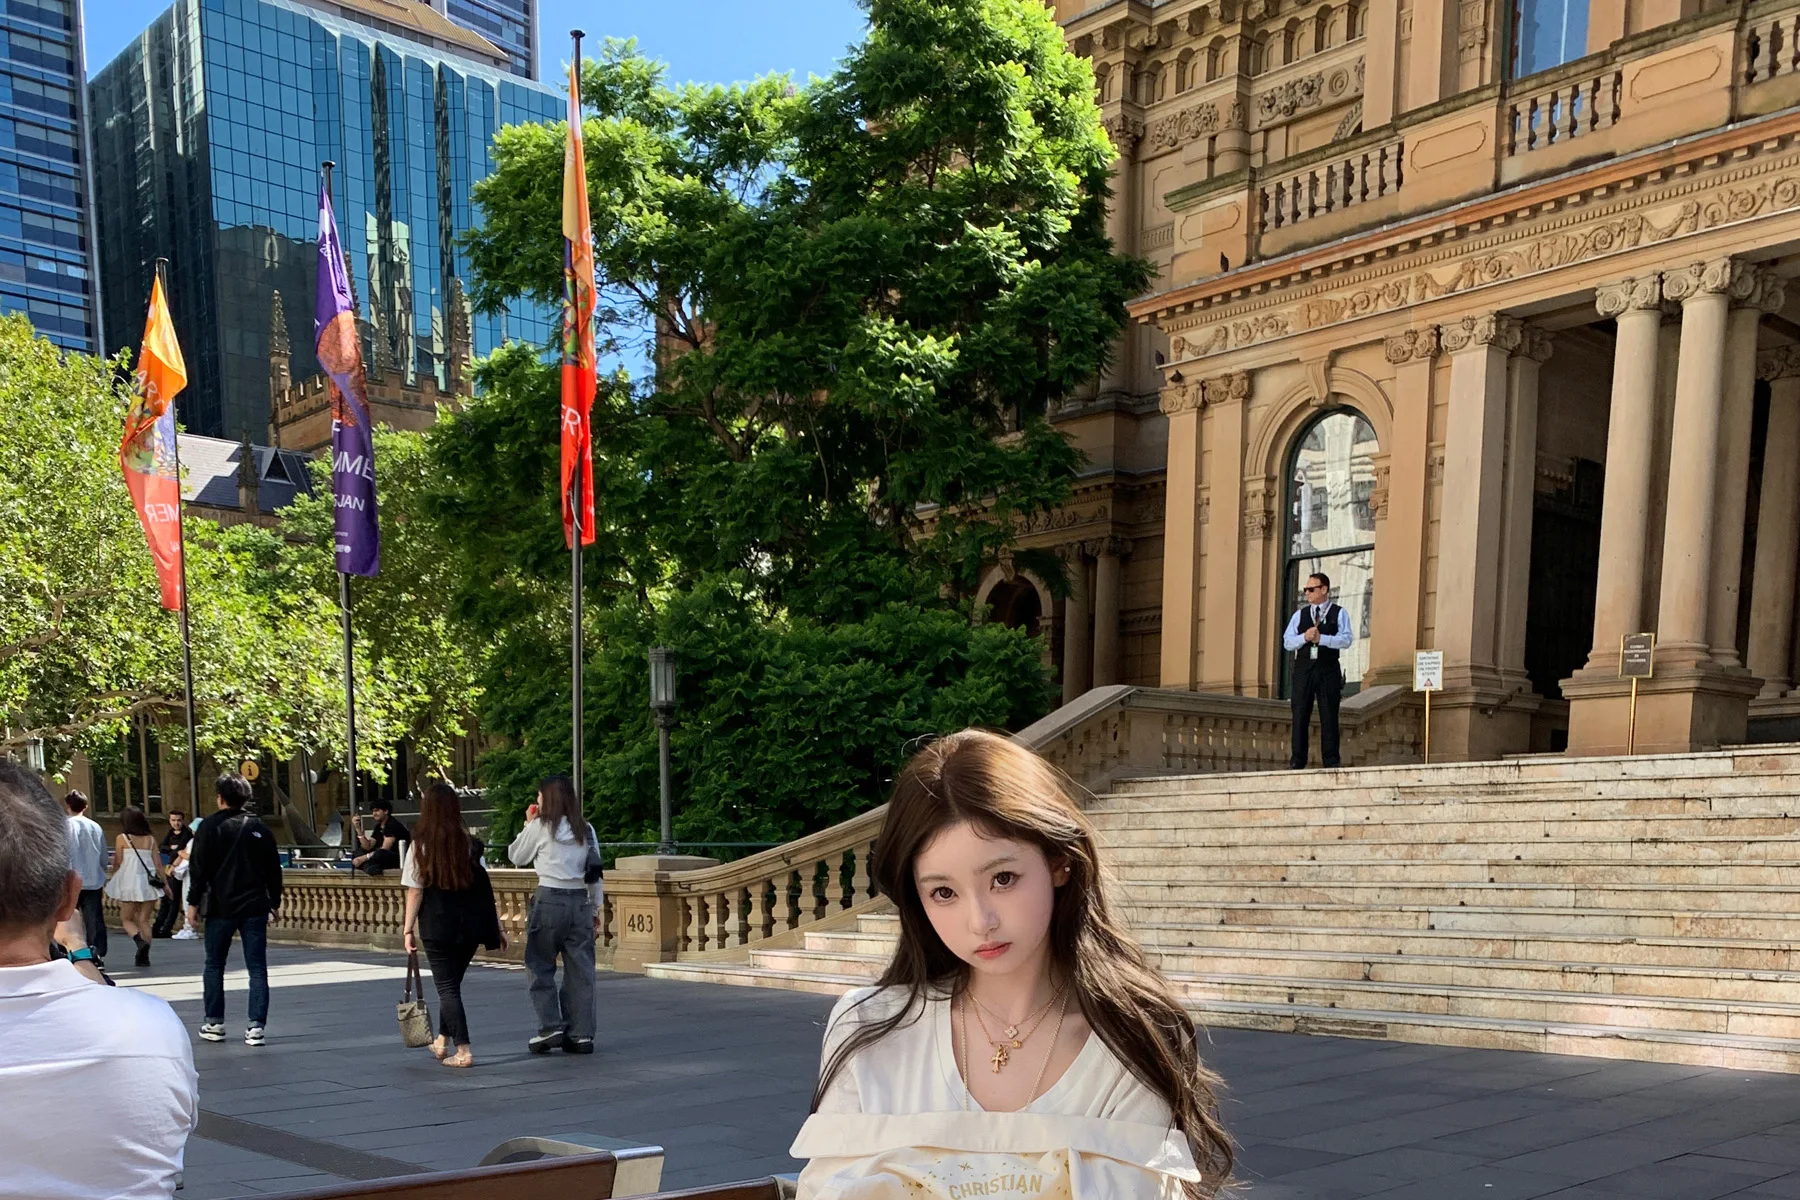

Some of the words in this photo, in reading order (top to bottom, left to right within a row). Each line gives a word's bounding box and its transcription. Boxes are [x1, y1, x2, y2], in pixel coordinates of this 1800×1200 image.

[338, 494, 365, 512] JAN
[627, 913, 654, 933] 483
[949, 1174, 1043, 1200] CHRISTIAN
